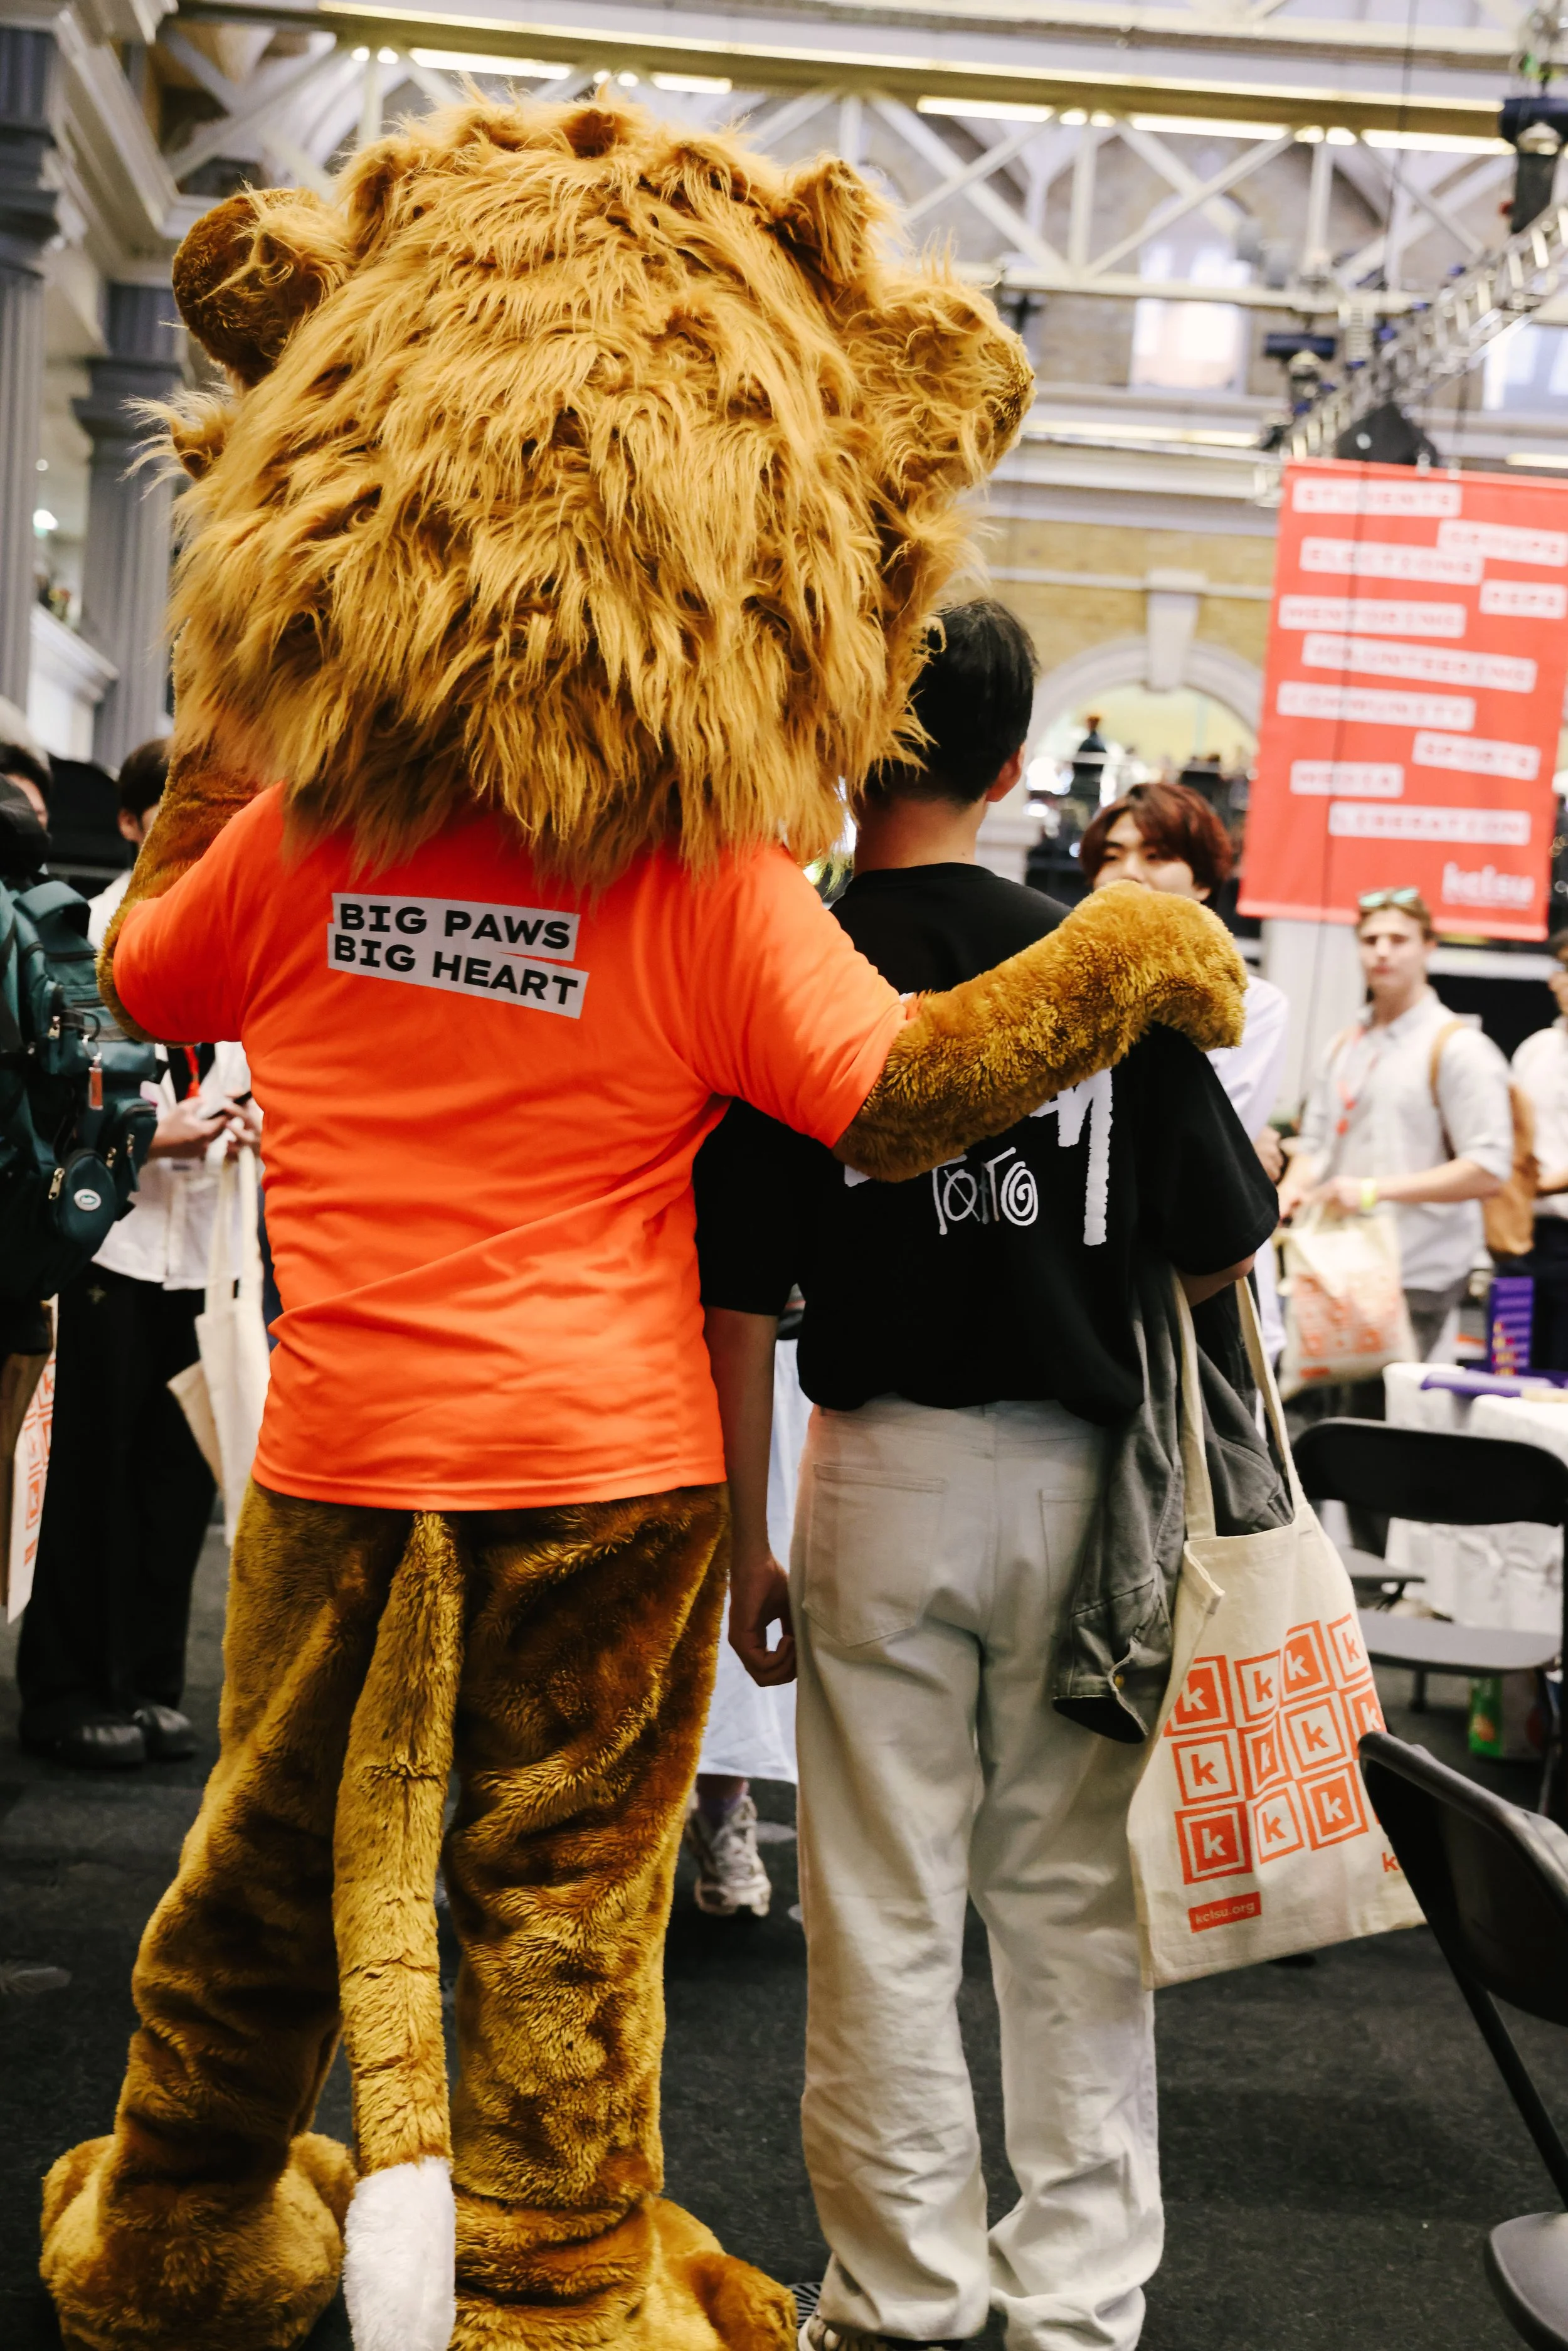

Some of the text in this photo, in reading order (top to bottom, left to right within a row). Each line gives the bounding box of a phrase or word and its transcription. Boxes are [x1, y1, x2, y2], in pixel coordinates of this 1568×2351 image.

[340, 903, 571, 950] BIG PAWS
[334, 934, 578, 1005] BIG HEART
[1254, 1670, 1277, 1702] k
[1286, 1651, 1309, 1681] k
[1345, 1633, 1361, 1663] k
[1191, 1754, 1218, 1786] k
[1301, 1721, 1329, 1753] k
[1362, 1701, 1382, 1733] k
[1202, 1791, 1345, 1860] k k k
[1195, 1903, 1255, 1924] kclsu.org
